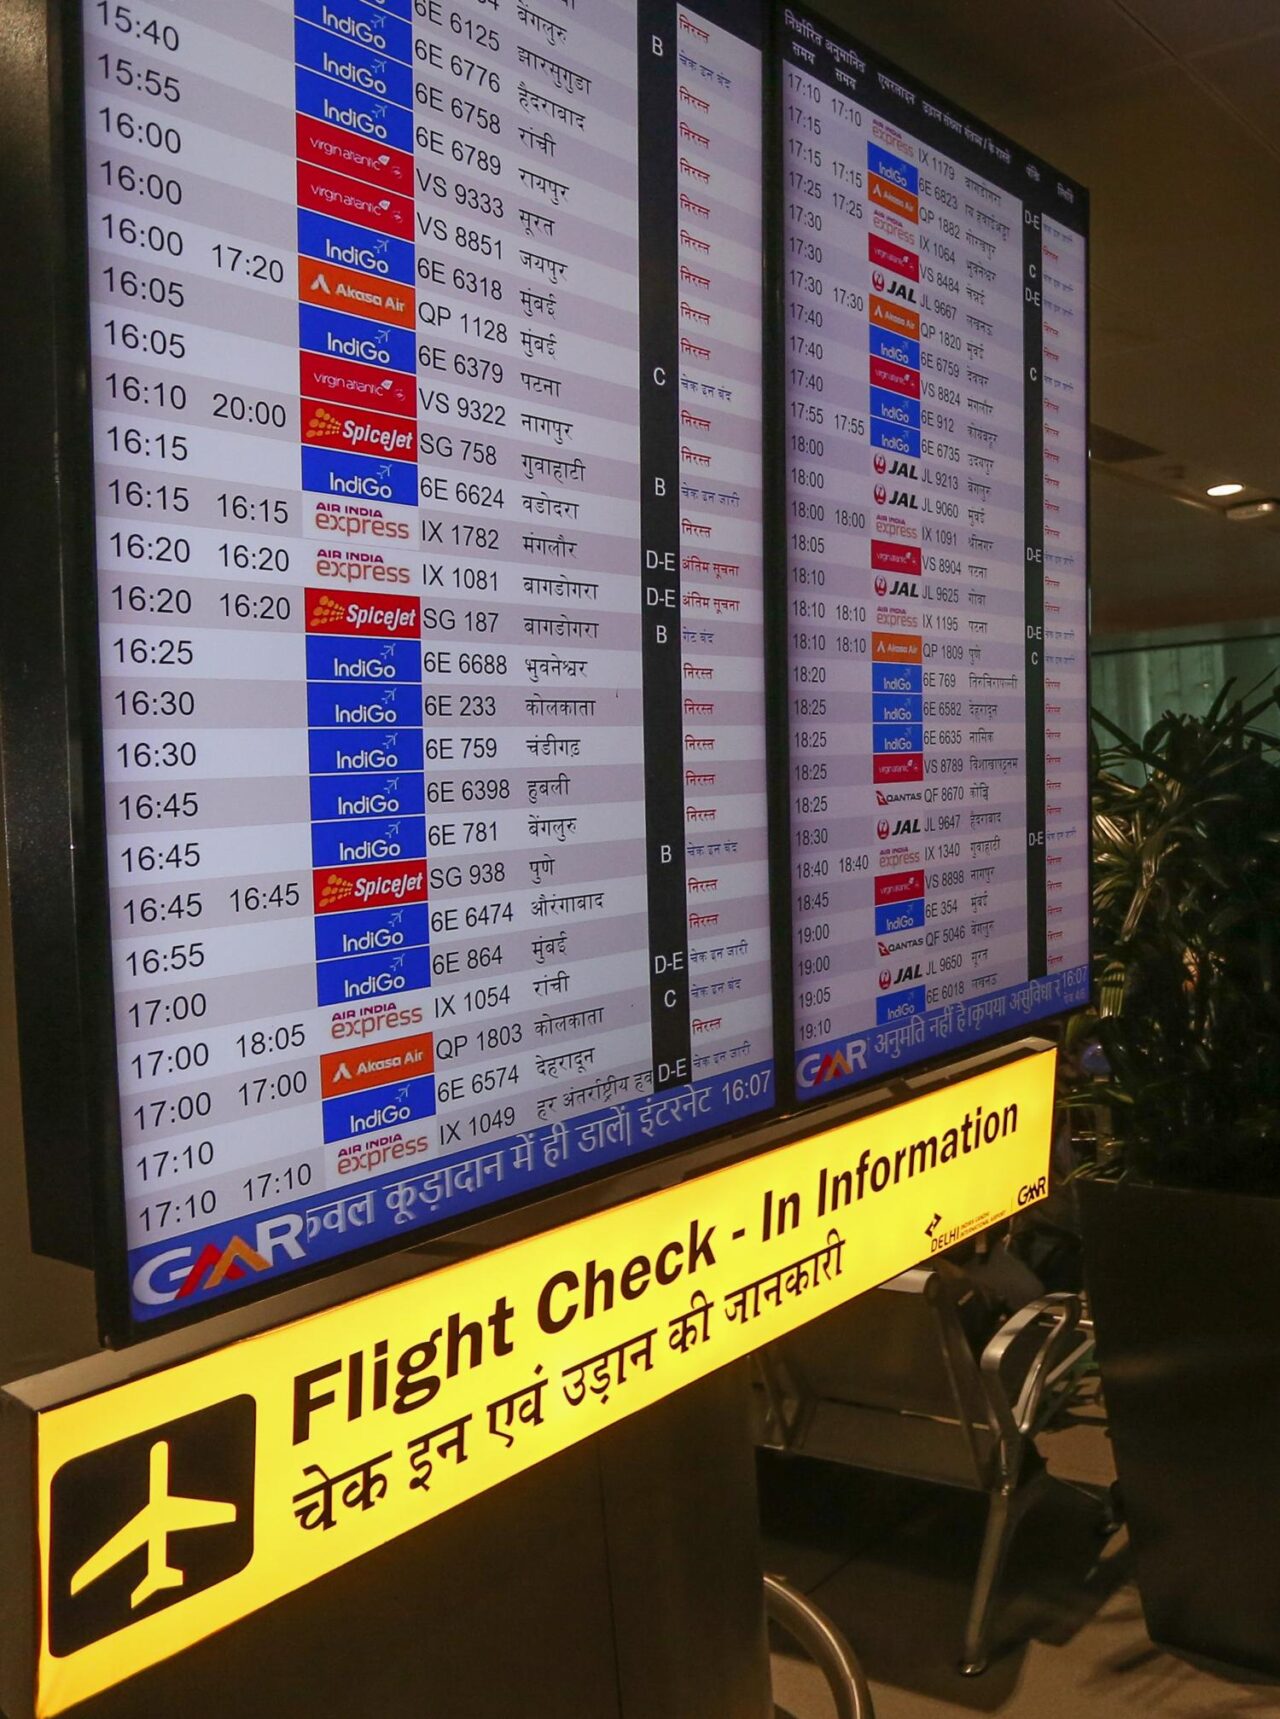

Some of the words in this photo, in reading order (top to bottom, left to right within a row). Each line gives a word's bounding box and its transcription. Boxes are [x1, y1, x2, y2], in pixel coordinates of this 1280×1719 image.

[102, 213, 183, 256] 16:00
[212, 244, 284, 283] 17:20
[103, 267, 184, 308] 16:05
[790, 270, 823, 296] 17:30
[335, 283, 382, 307] Akasa
[385, 297, 405, 313] Air
[833, 287, 863, 312] 17:30
[418, 301, 452, 326] QP
[460, 313, 508, 343] 1128
[327, 331, 391, 364] IndiGo
[920, 322, 936, 339] QP
[939, 330, 962, 351] 1820
[418, 345, 447, 371] 6E
[454, 354, 503, 384] 6379
[653, 367, 666, 386] C
[106, 373, 186, 410] 16:10
[213, 393, 286, 428] 20:00
[342, 420, 413, 451] SpiceJet
[420, 433, 453, 458] SG
[460, 440, 497, 466] 758
[108, 479, 189, 512] 16:15
[655, 477, 666, 496] B
[217, 493, 288, 524] 16:15
[315, 502, 340, 514] AIR
[345, 506, 383, 519] INDIA
[792, 501, 824, 521] 18:00
[835, 509, 865, 529] 18:00
[315, 513, 409, 540] express
[422, 520, 443, 543] IX
[451, 524, 499, 550] 1782
[922, 526, 932, 542] IX
[935, 529, 957, 546] 1091
[110, 532, 190, 563] 16:20
[218, 543, 289, 572] 16:20
[646, 549, 676, 572] D-E
[423, 563, 444, 587] IX
[452, 567, 497, 591] 1081
[112, 585, 192, 614] 16:20
[220, 593, 291, 620] 16:20
[646, 587, 676, 608] D-E
[793, 600, 825, 618] 18:10
[346, 605, 416, 631] SpiceJet
[423, 608, 455, 630] SG
[464, 611, 499, 633] 187
[836, 604, 866, 622] 18:10
[922, 614, 933, 629] IX
[936, 616, 958, 631] 1195
[656, 625, 667, 644] B
[794, 633, 826, 651] 18:10
[836, 636, 866, 653] 18:10
[113, 638, 193, 665] 16:25
[423, 651, 452, 673] 6E
[458, 653, 507, 675] 6688
[922, 643, 938, 658] QP
[941, 645, 964, 660] 1809
[334, 658, 396, 678] IndiGo
[115, 690, 195, 716] 16:30
[424, 695, 453, 716] 6E
[459, 695, 496, 716] 233
[425, 738, 454, 760] 6E
[460, 737, 497, 759] 759
[795, 731, 827, 748] 18:25
[923, 730, 937, 745] 6E
[939, 730, 963, 744] 6635
[117, 742, 196, 768] 16:30
[924, 759, 938, 774] VS
[940, 758, 964, 773] 8789
[795, 763, 827, 781] 18:25
[427, 782, 455, 802] 6E
[461, 779, 510, 801] 6398
[119, 792, 198, 820] 16:45
[796, 828, 828, 846] 18:30
[892, 818, 921, 836] JAL
[661, 844, 672, 864] B
[354, 872, 423, 901] SpiceJet
[430, 866, 462, 889] SG
[469, 862, 505, 885] 938
[123, 892, 202, 925] 16:45
[230, 882, 300, 912] 16:45
[431, 909, 460, 932] 6E
[465, 902, 514, 928] 6474
[888, 937, 924, 953] QANTAS
[126, 942, 205, 976] 16:55
[432, 951, 460, 975] 6E
[467, 944, 503, 969] 864
[654, 951, 684, 974] D-E
[1062, 965, 1088, 988] 16:07
[129, 993, 206, 1028] 17:00
[435, 994, 456, 1018] IX
[464, 984, 510, 1012] 1054
[664, 989, 677, 1008] C
[236, 1023, 305, 1058] 18:05
[436, 1035, 468, 1060] QP
[476, 1023, 522, 1051] 1803
[131, 1042, 209, 1079] 17:00
[356, 1056, 401, 1074] Akasa
[404, 1050, 423, 1064] Air
[238, 1070, 307, 1106] 17:00
[437, 1077, 465, 1103] 6E
[471, 1064, 519, 1094] 6574
[721, 1070, 772, 1106] 16:07
[134, 1092, 211, 1130] 17:00
[350, 1104, 411, 1133] IndiGo
[543, 1120, 569, 1169] ही
[137, 1141, 214, 1181] 17:10
[931, 1226, 960, 1253] DELHI
[292, 1296, 514, 1446] Flight
[536, 1219, 717, 1334] Check
[762, 1190, 801, 1243] In
[817, 1102, 1018, 1217] Information
[292, 1451, 393, 1532] चेक
[407, 1414, 473, 1492] इन
[486, 1364, 549, 1447] एवं
[561, 1328, 658, 1406] उड़ान
[667, 1290, 715, 1354] की
[723, 1228, 847, 1325] जानकारी
